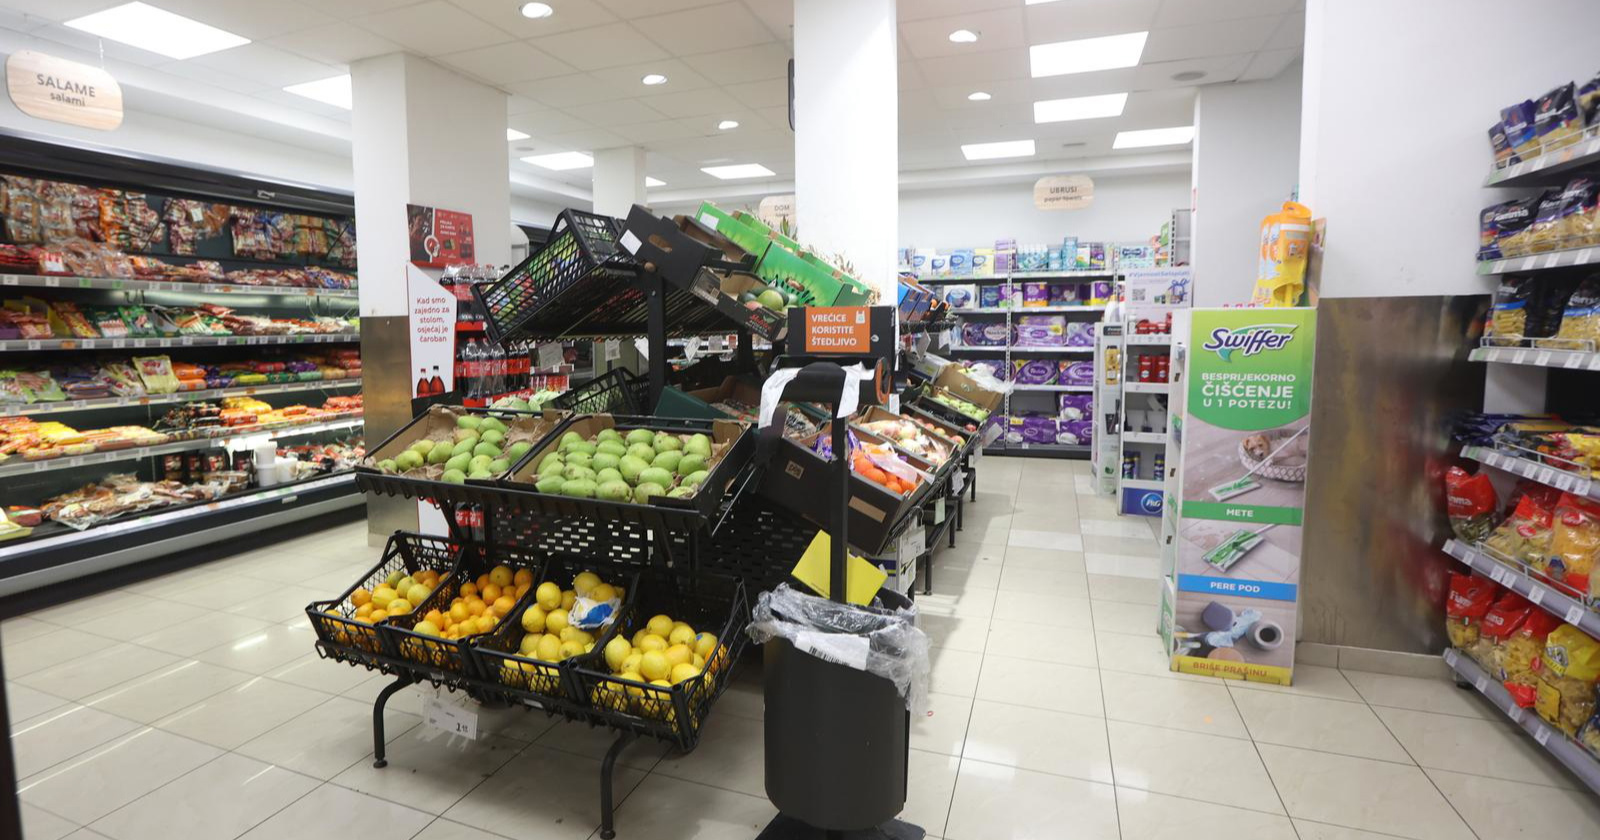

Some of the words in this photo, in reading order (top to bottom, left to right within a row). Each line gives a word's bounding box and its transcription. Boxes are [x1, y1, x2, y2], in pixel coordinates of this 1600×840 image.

[36, 73, 96, 98] SALAME
[50, 92, 86, 107] salami
[1050, 186, 1078, 194] UBRUSI
[774, 204, 790, 212] DOM
[416, 297, 430, 305] Kad
[414, 307, 441, 315] zajedno
[811, 313, 847, 322] VREĆICE
[417, 326, 440, 334] osjećaj
[811, 326, 854, 334] KORISTITE
[419, 335, 447, 343] čaroban
[811, 337, 857, 346] ŠTEDLJIVO
[1202, 327, 1293, 356] Swiffer
[1202, 372, 1296, 382] BESPRIJEKORNO
[1202, 380, 1294, 398] ČIŠĆENJE
[1203, 399, 1213, 407] U
[1217, 399, 1223, 407] 1
[1228, 399, 1292, 409] POTEZU!
[1226, 508, 1254, 518] METE
[1210, 581, 1236, 591] PERE
[1238, 584, 1261, 593] POD
[1193, 661, 1221, 672] BRIŠE
[1223, 664, 1267, 677] PRAŠINU
